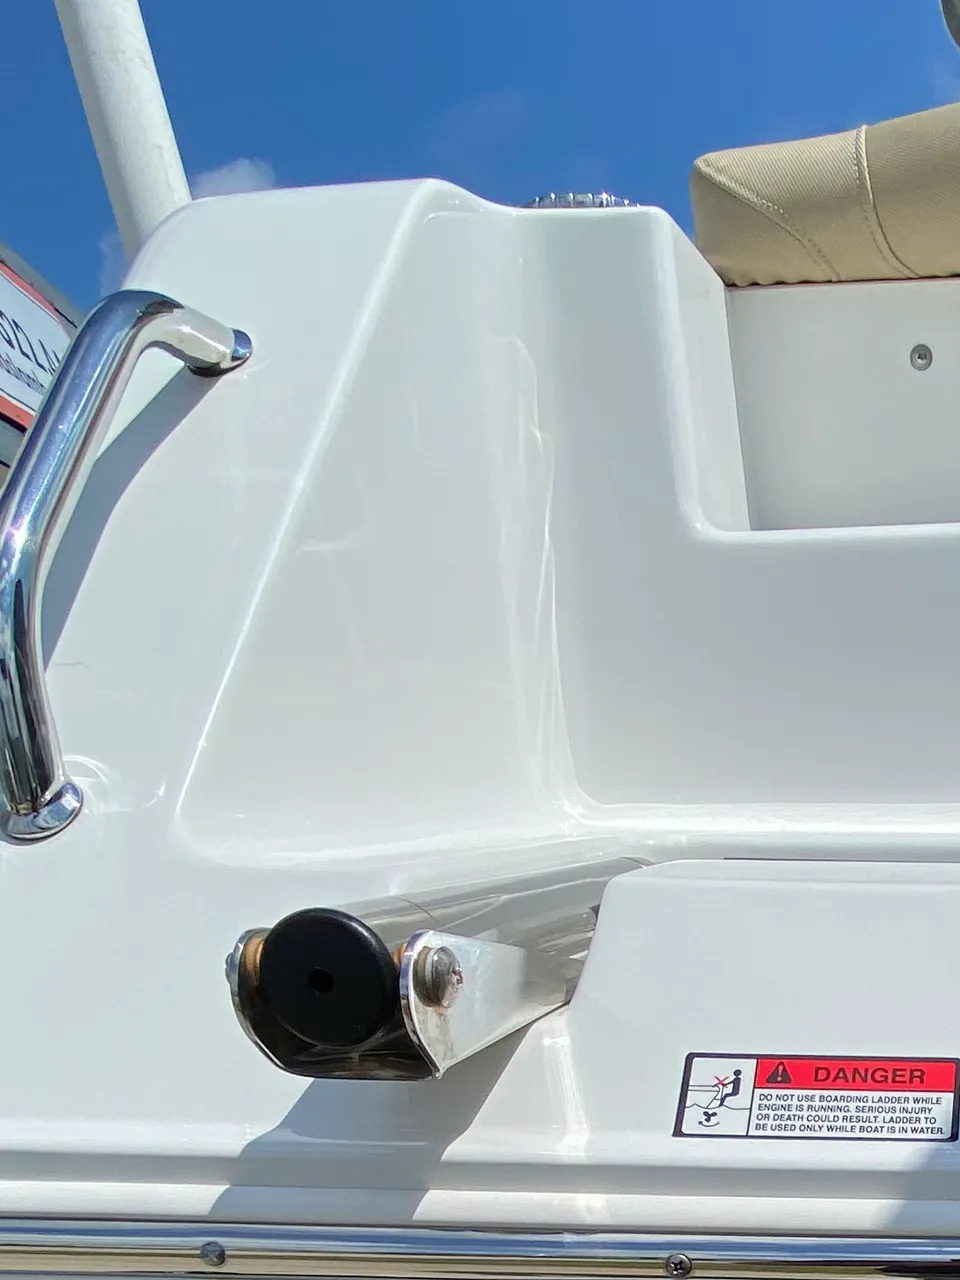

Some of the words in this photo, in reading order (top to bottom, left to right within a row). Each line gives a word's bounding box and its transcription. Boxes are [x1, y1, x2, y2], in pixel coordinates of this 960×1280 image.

[813, 1066, 926, 1084] DANGER
[759, 1093, 773, 1101] DO
[775, 1094, 795, 1102] NOT
[797, 1094, 816, 1102] USE
[819, 1095, 868, 1103] BOARDING
[872, 1096, 909, 1104] LADDER
[913, 1096, 942, 1105] WHILE
[758, 1103, 793, 1112] ENGINE
[795, 1104, 804, 1112] IS
[807, 1105, 852, 1113] RUNNING.
[855, 1105, 896, 1114] SERIOUS
[899, 1106, 933, 1114] INJURY
[756, 1113, 770, 1121] OR
[773, 1113, 804, 1122] DEATH
[806, 1114, 839, 1122] COULD
[883, 1116, 921, 1124] LADDER
[924, 1117, 937, 1125] TO
[755, 1123, 768, 1131] BE
[770, 1123, 796, 1131] USED
[799, 1124, 824, 1132] ONLY
[826, 1124, 856, 1133] WHILE
[859, 1125, 885, 1133] BOAT
[898, 1126, 908, 1134] IN
[911, 1126, 945, 1135] WATER.
